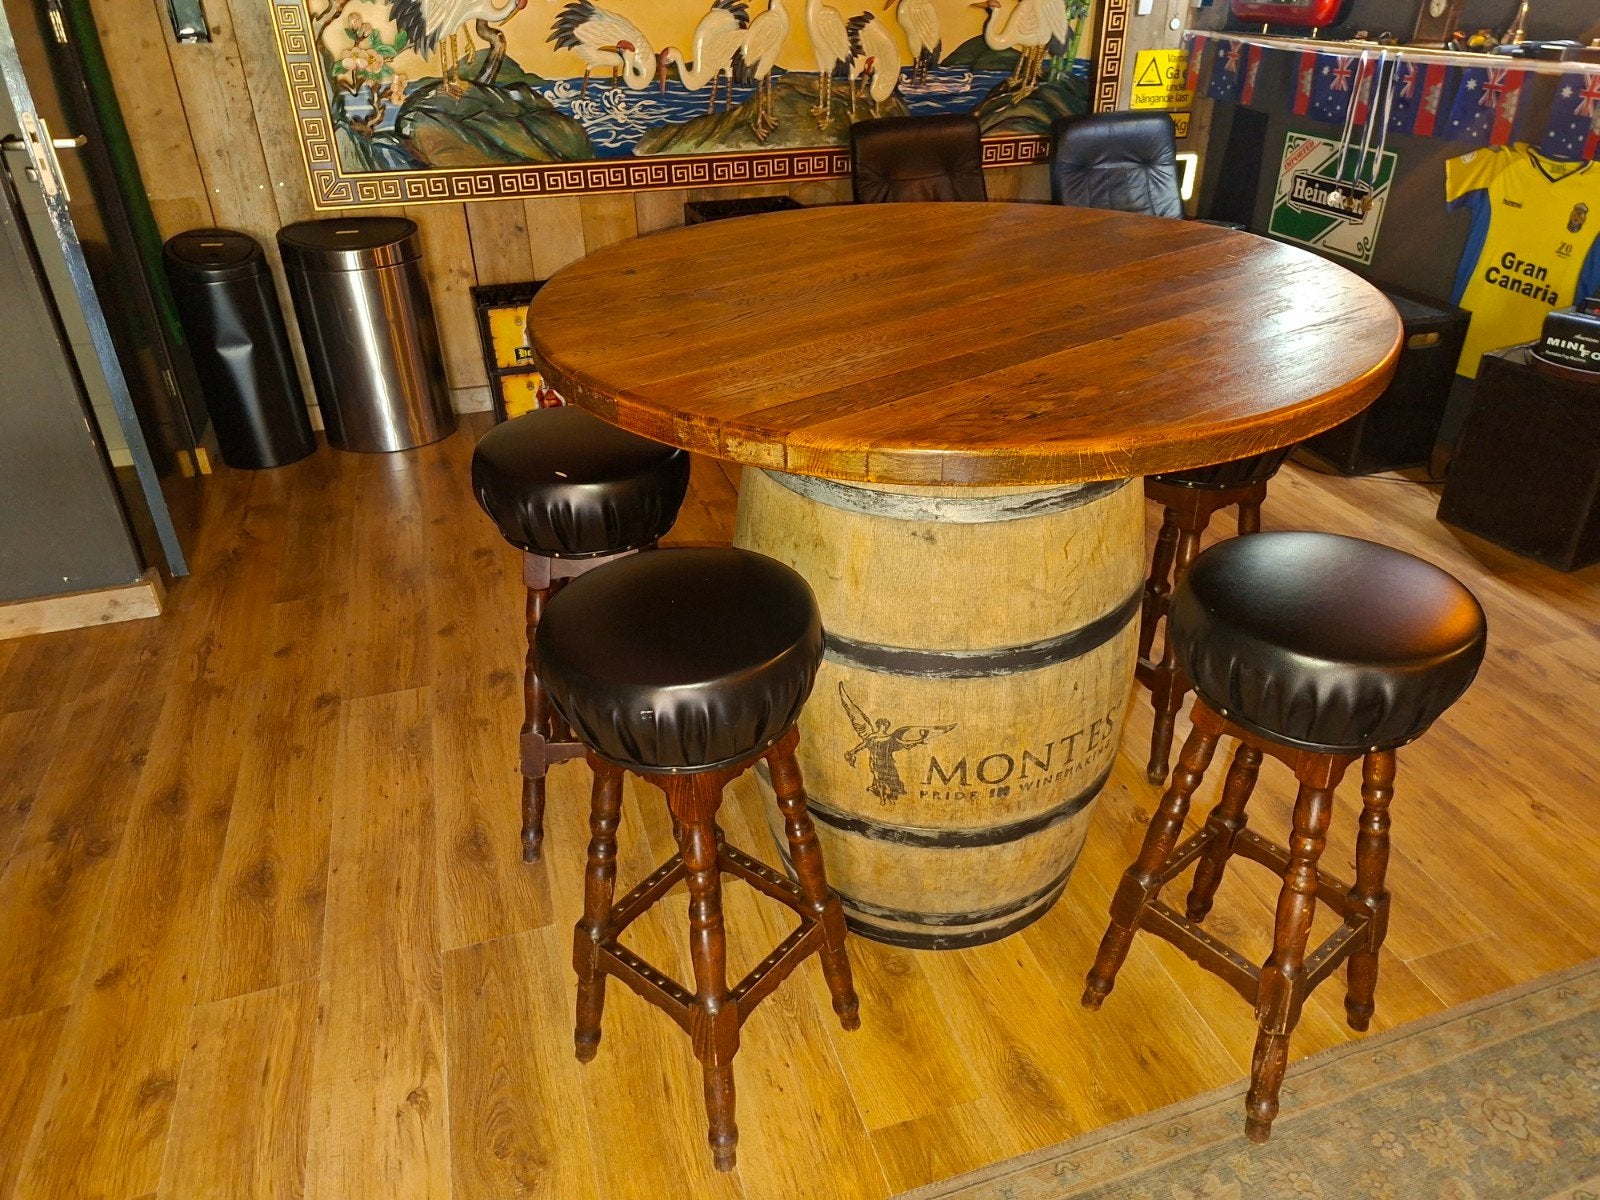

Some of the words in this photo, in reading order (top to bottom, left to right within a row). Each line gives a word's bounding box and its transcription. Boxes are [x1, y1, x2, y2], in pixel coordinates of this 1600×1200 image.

[1485, 266, 1558, 306] Canaria
[1501, 252, 1548, 281] Gran
[1546, 336, 1586, 352] MINI
[919, 703, 1119, 787] MONTES
[919, 790, 980, 800] PRIDE
[1019, 738, 1112, 791] WINEMAKING
